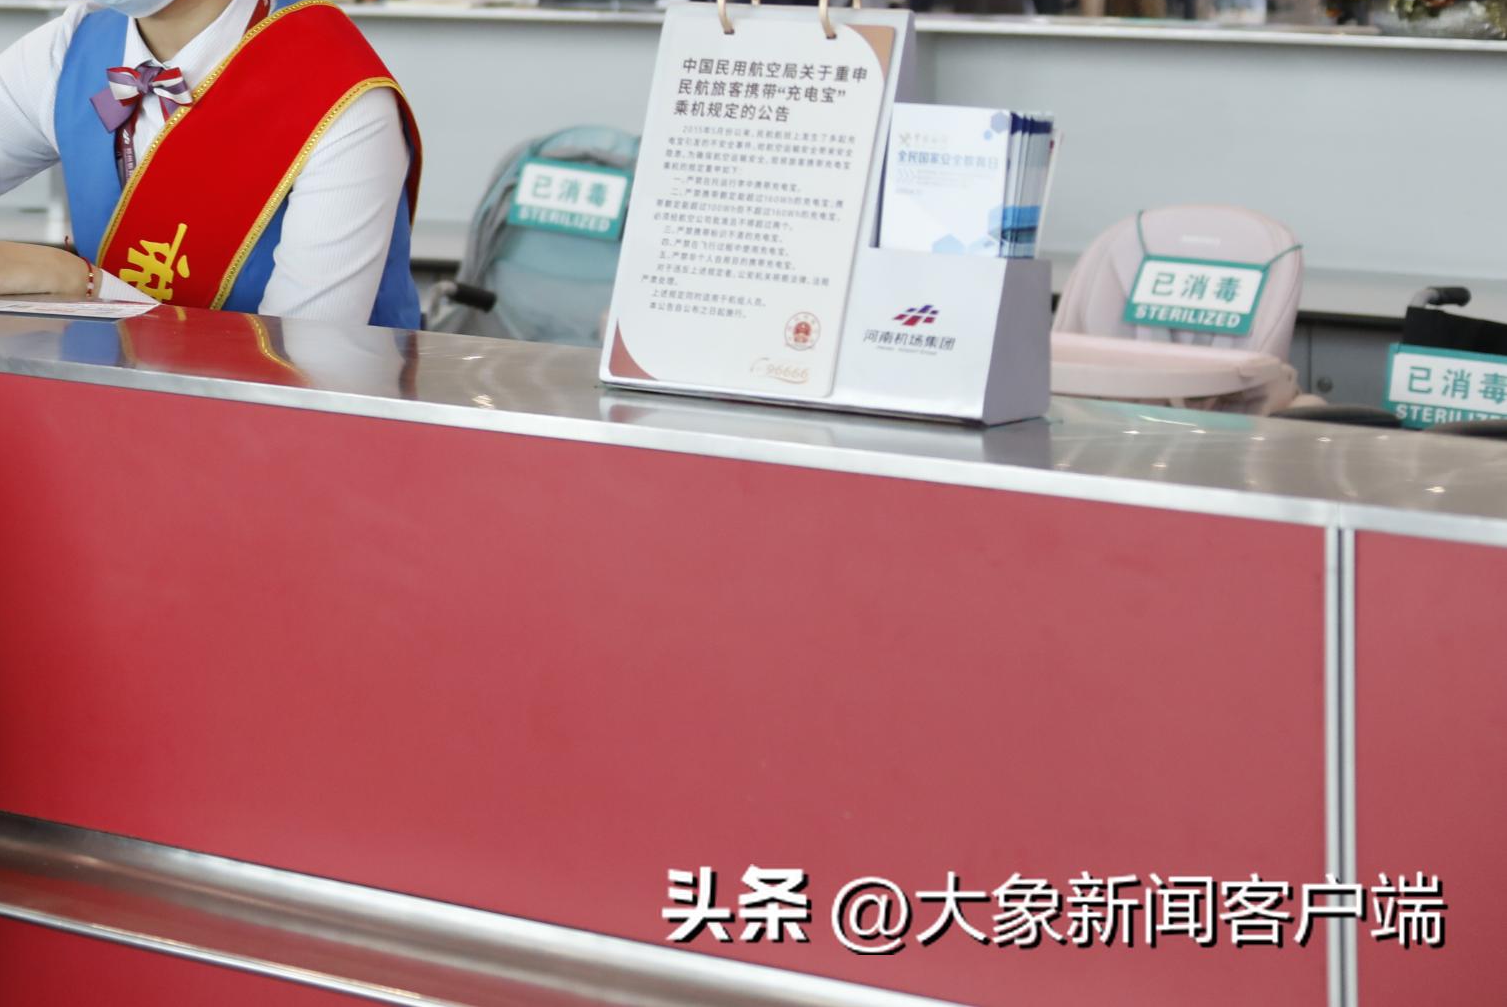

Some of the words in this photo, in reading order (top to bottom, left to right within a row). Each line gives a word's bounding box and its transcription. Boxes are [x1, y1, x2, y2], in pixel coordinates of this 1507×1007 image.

[682, 57, 868, 83] 中国民用航空局关于重申
[673, 100, 791, 123] 乘机规定的公告
[1151, 271, 1242, 303] 已消毒
[1135, 305, 1241, 328] STERILIZED
[862, 328, 957, 351] 河南机场集团
[1408, 366, 1507, 405] 已消毒
